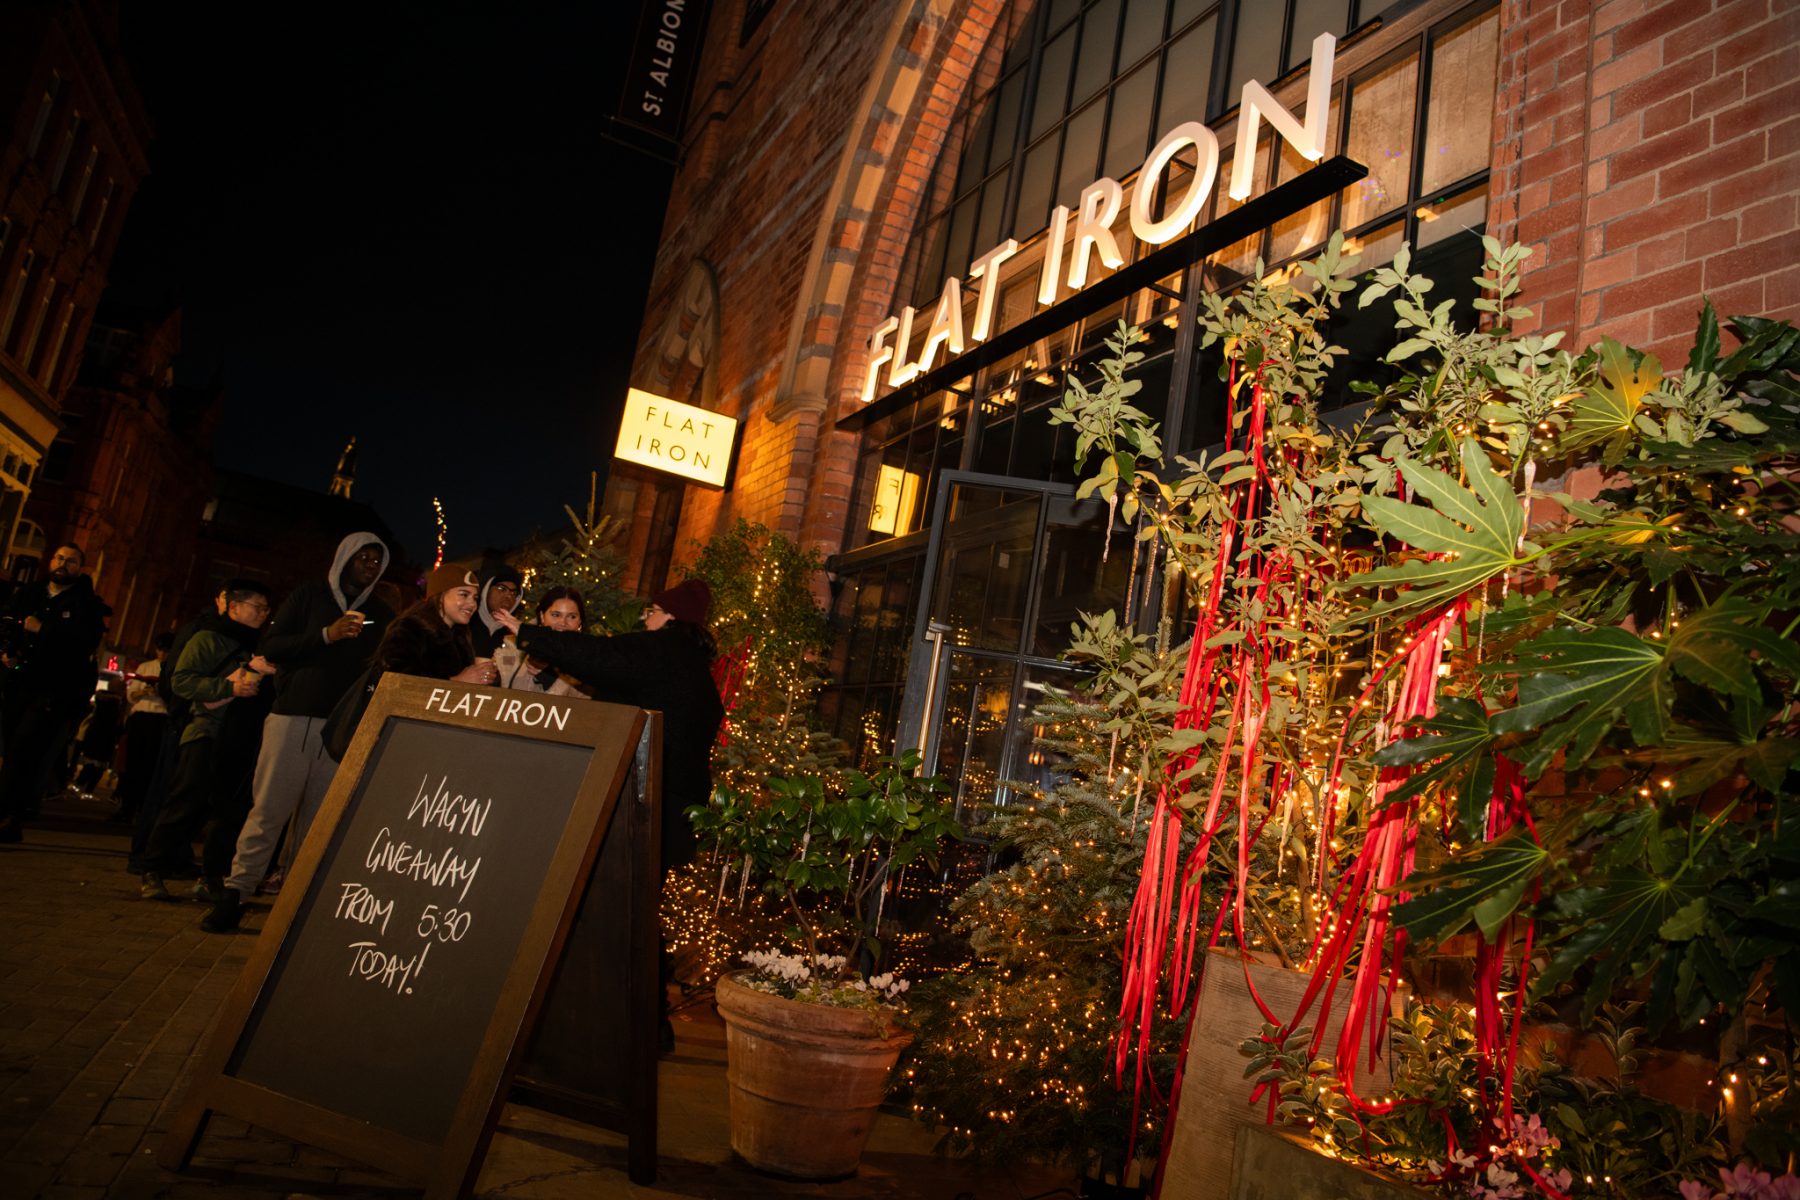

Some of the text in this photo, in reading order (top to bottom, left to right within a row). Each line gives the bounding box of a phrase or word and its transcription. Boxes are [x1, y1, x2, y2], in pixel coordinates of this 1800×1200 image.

[860, 32, 1337, 402] FLAT IRON
[646, 406, 714, 439] FLAT
[636, 434, 710, 470] IRON
[425, 688, 571, 731] FLAT IRON
[365, 827, 481, 903] GIVEAWAY
[335, 882, 471, 943] FROM 5:30
[348, 941, 431, 995] TODAY!
